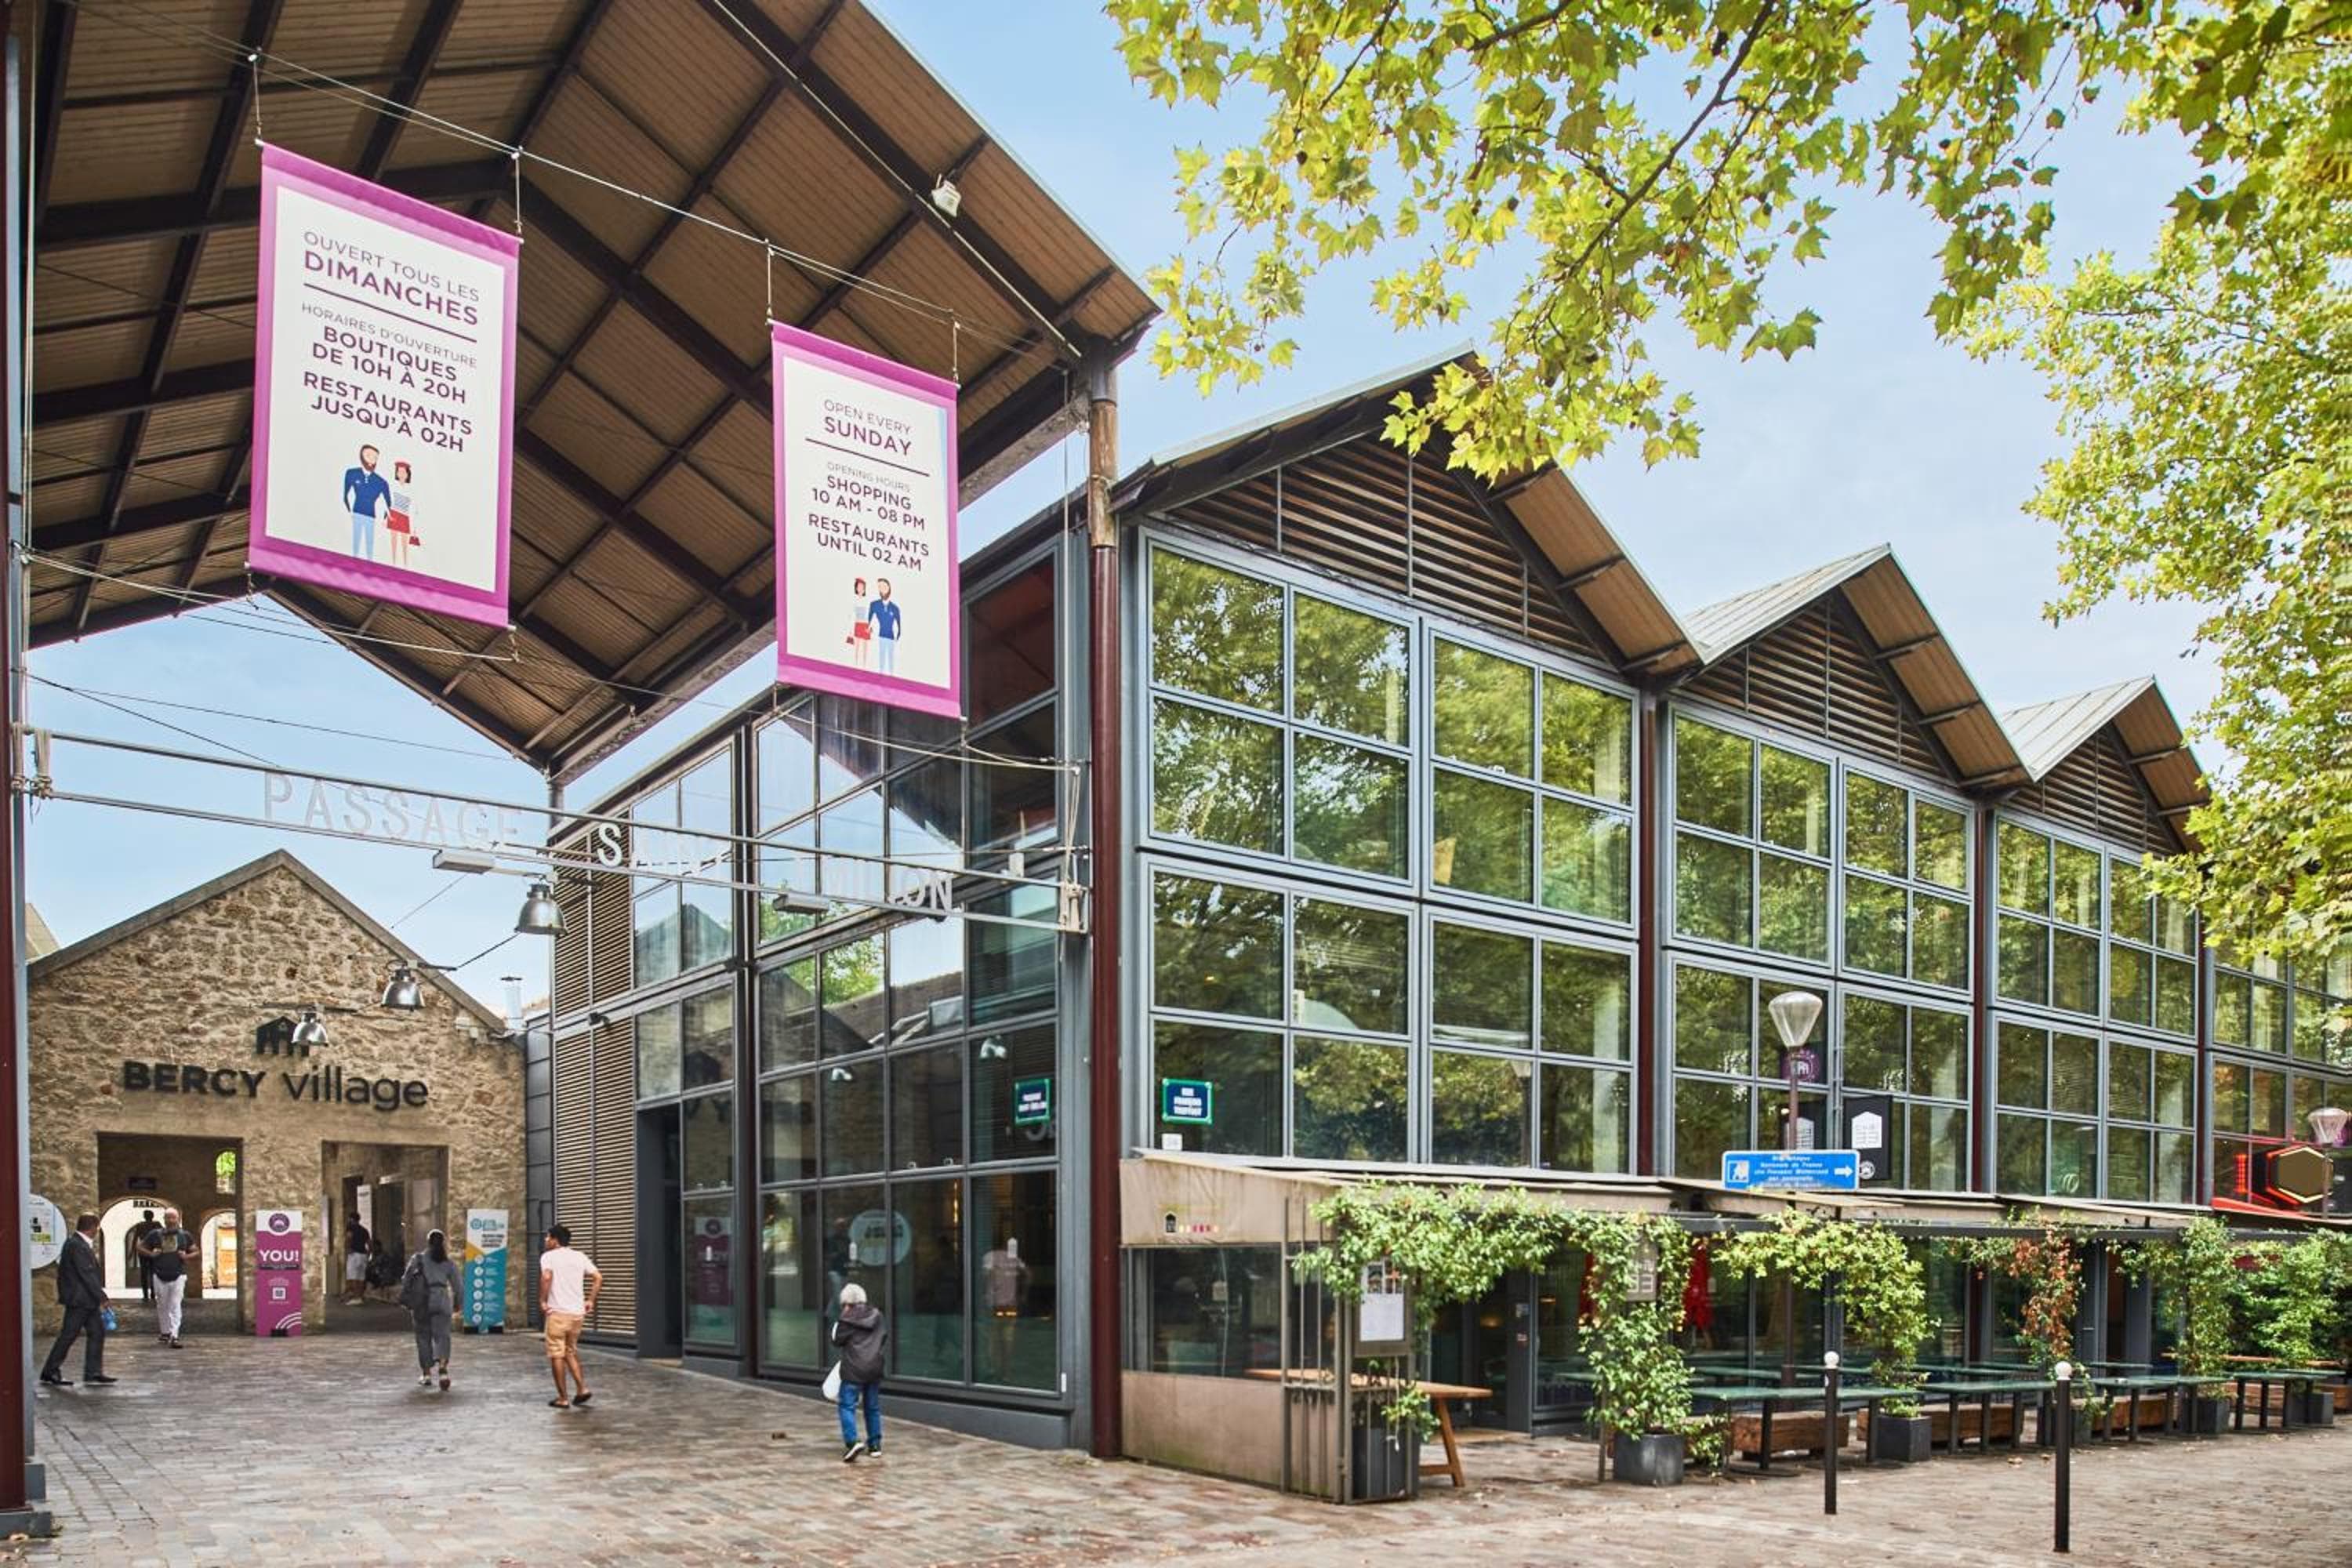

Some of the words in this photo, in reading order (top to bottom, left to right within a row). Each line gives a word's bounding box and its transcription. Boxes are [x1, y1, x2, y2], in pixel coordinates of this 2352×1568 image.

[304, 231, 384, 268] OUVERT
[392, 261, 441, 290] TOUS
[448, 281, 479, 302] LES
[304, 249, 478, 325] DIMANCHES
[302, 303, 376, 336] HORAIRES
[380, 328, 477, 368] D'OUVERTURE
[324, 325, 457, 382] BOUTIQUES
[312, 342, 343, 366] DE
[350, 354, 392, 381] 10H
[399, 366, 416, 389] À
[423, 378, 466, 405] 20H
[303, 371, 473, 435] RESTAURANTS
[824, 399, 863, 421] OPEN
[867, 412, 911, 435] EVERY
[420, 426, 463, 452] 02H
[824, 416, 912, 456] SUNDAY
[826, 474, 912, 511] SHOPPING
[827, 461, 874, 483] OPENING
[811, 487, 830, 504] 10
[835, 495, 862, 513] AM
[877, 506, 898, 523] 08
[902, 513, 925, 532] PM
[808, 513, 929, 557] RESTAURANTS
[817, 532, 867, 557] UNTIL
[872, 546, 892, 564] 02
[897, 554, 922, 572] AM
[263, 771, 522, 847] PASSAGE
[123, 1060, 267, 1099] BERCY
[282, 1065, 429, 1112] village
[260, 1249, 299, 1262] YOU!
